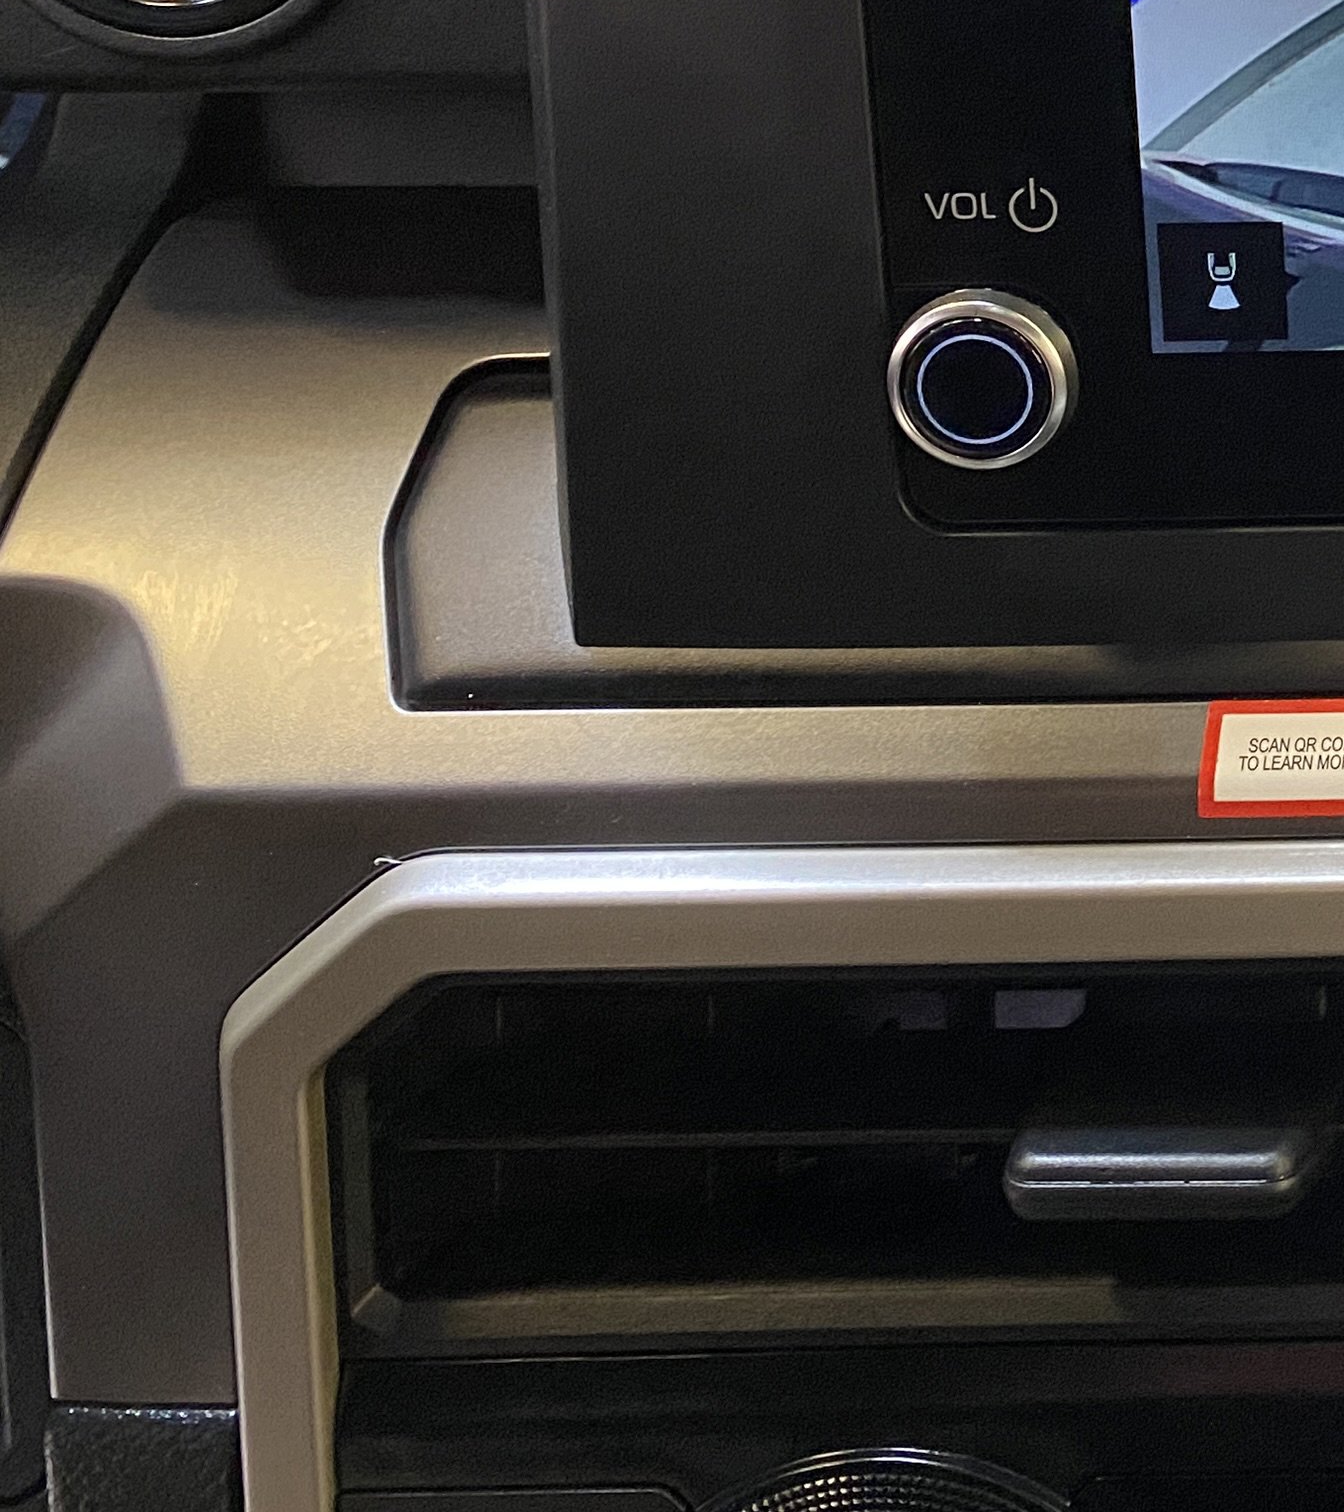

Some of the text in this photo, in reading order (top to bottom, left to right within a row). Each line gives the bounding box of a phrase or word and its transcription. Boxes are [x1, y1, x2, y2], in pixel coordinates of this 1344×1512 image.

[924, 192, 997, 220] VOL
[1248, 738, 1290, 753] SCAN
[1294, 737, 1317, 753] QR
[1239, 756, 1260, 771] TO
[1263, 755, 1314, 771] LEARN
